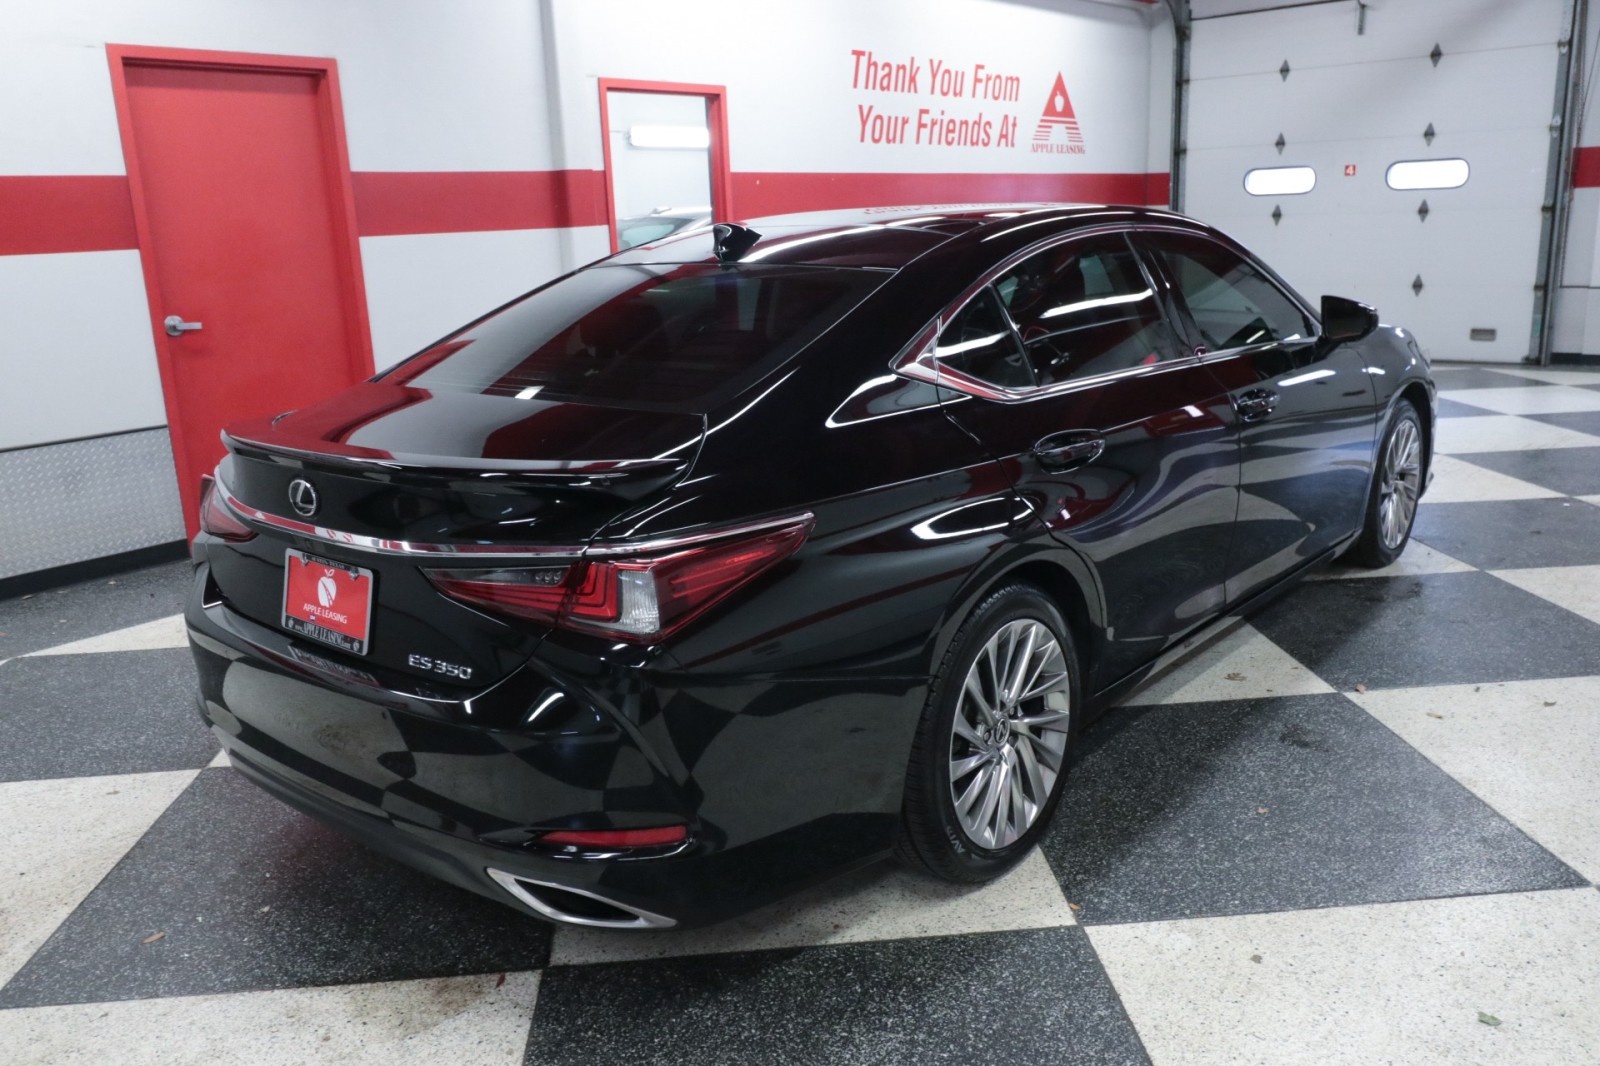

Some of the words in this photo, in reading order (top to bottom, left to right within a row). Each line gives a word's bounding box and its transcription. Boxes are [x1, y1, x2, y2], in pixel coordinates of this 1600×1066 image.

[851, 49, 920, 94] Thank
[929, 58, 965, 97] You
[972, 64, 1021, 102] From
[858, 104, 909, 144] Your
[915, 108, 992, 148] Friends
[997, 114, 1017, 148] At
[1031, 143, 1055, 154] APPLE
[1056, 144, 1086, 155] LEASING
[303, 603, 322, 616] APPLE
[322, 608, 348, 625] LEASING
[408, 654, 432, 670] ES
[434, 660, 472, 680] 350
